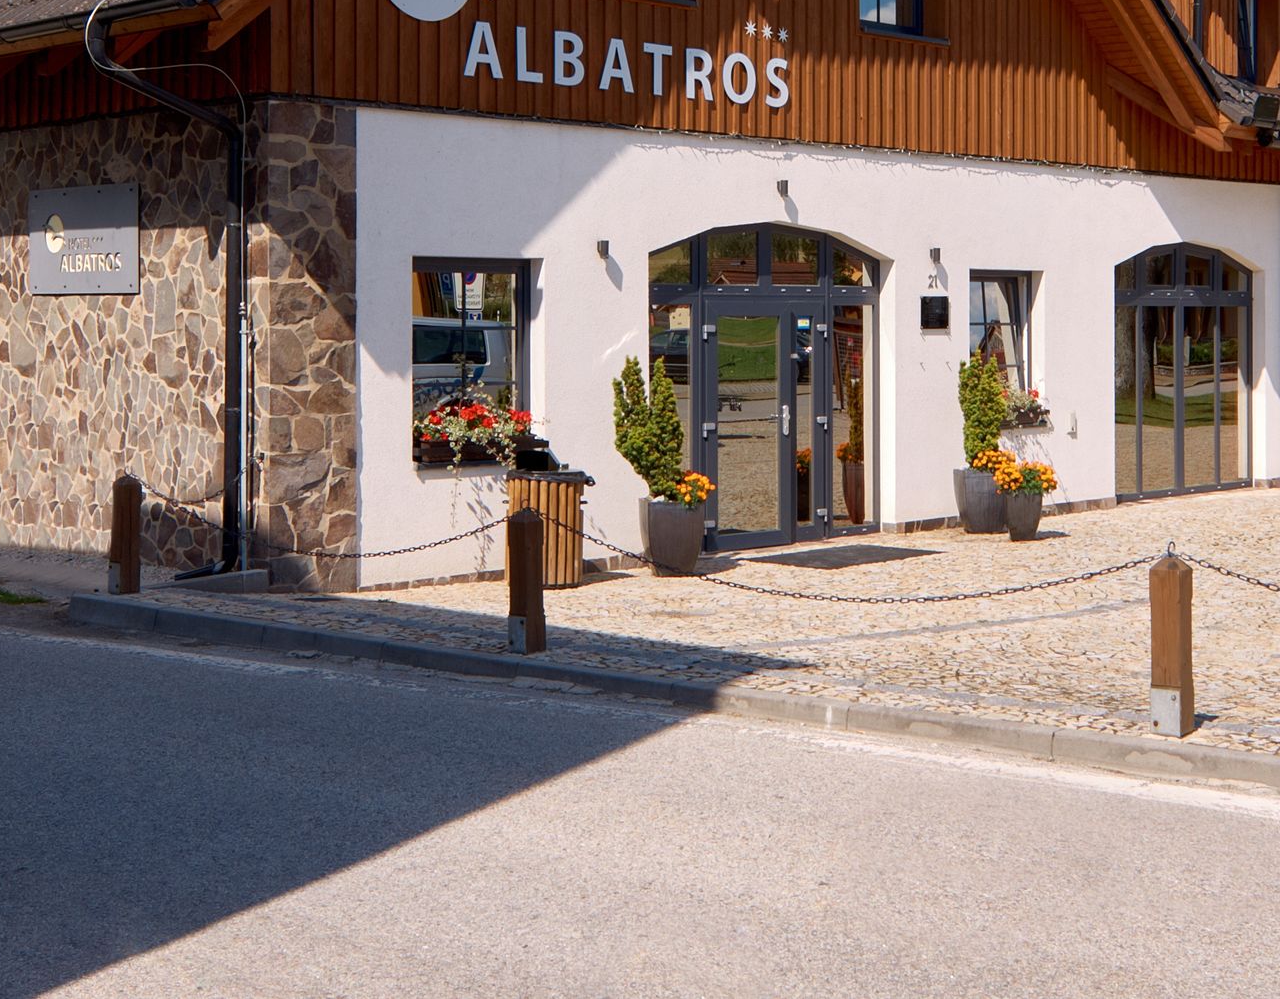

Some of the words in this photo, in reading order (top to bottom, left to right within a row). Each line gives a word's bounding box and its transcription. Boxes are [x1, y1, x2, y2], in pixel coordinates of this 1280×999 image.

[463, 20, 790, 109] ALBATROS
[60, 252, 122, 273] ALBATROS
[927, 274, 938, 290] 21
